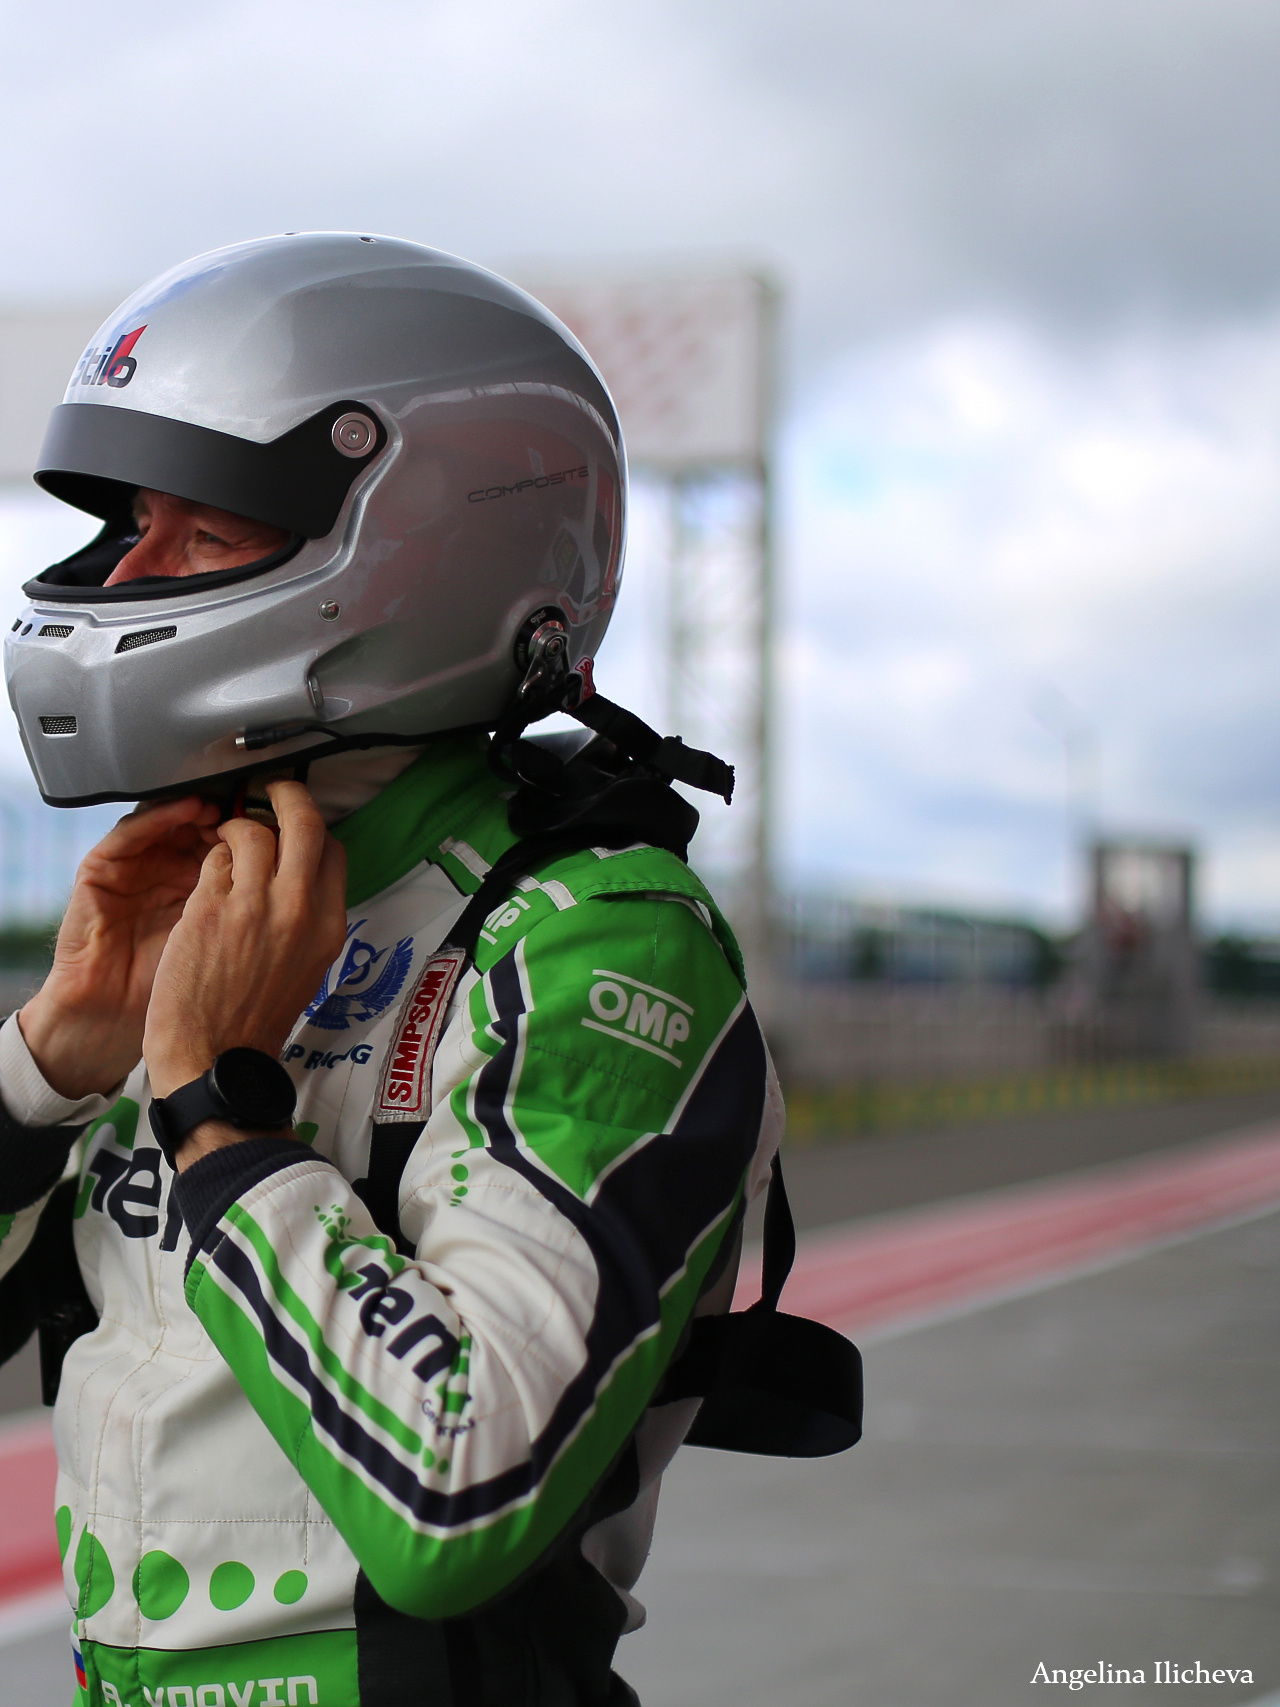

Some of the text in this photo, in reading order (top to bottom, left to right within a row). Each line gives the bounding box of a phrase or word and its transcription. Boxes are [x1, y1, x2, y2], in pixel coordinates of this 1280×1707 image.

[468, 465, 589, 503] COMPOSITE
[387, 970, 448, 1103] SIMPSON
[588, 980, 691, 1049] OMP
